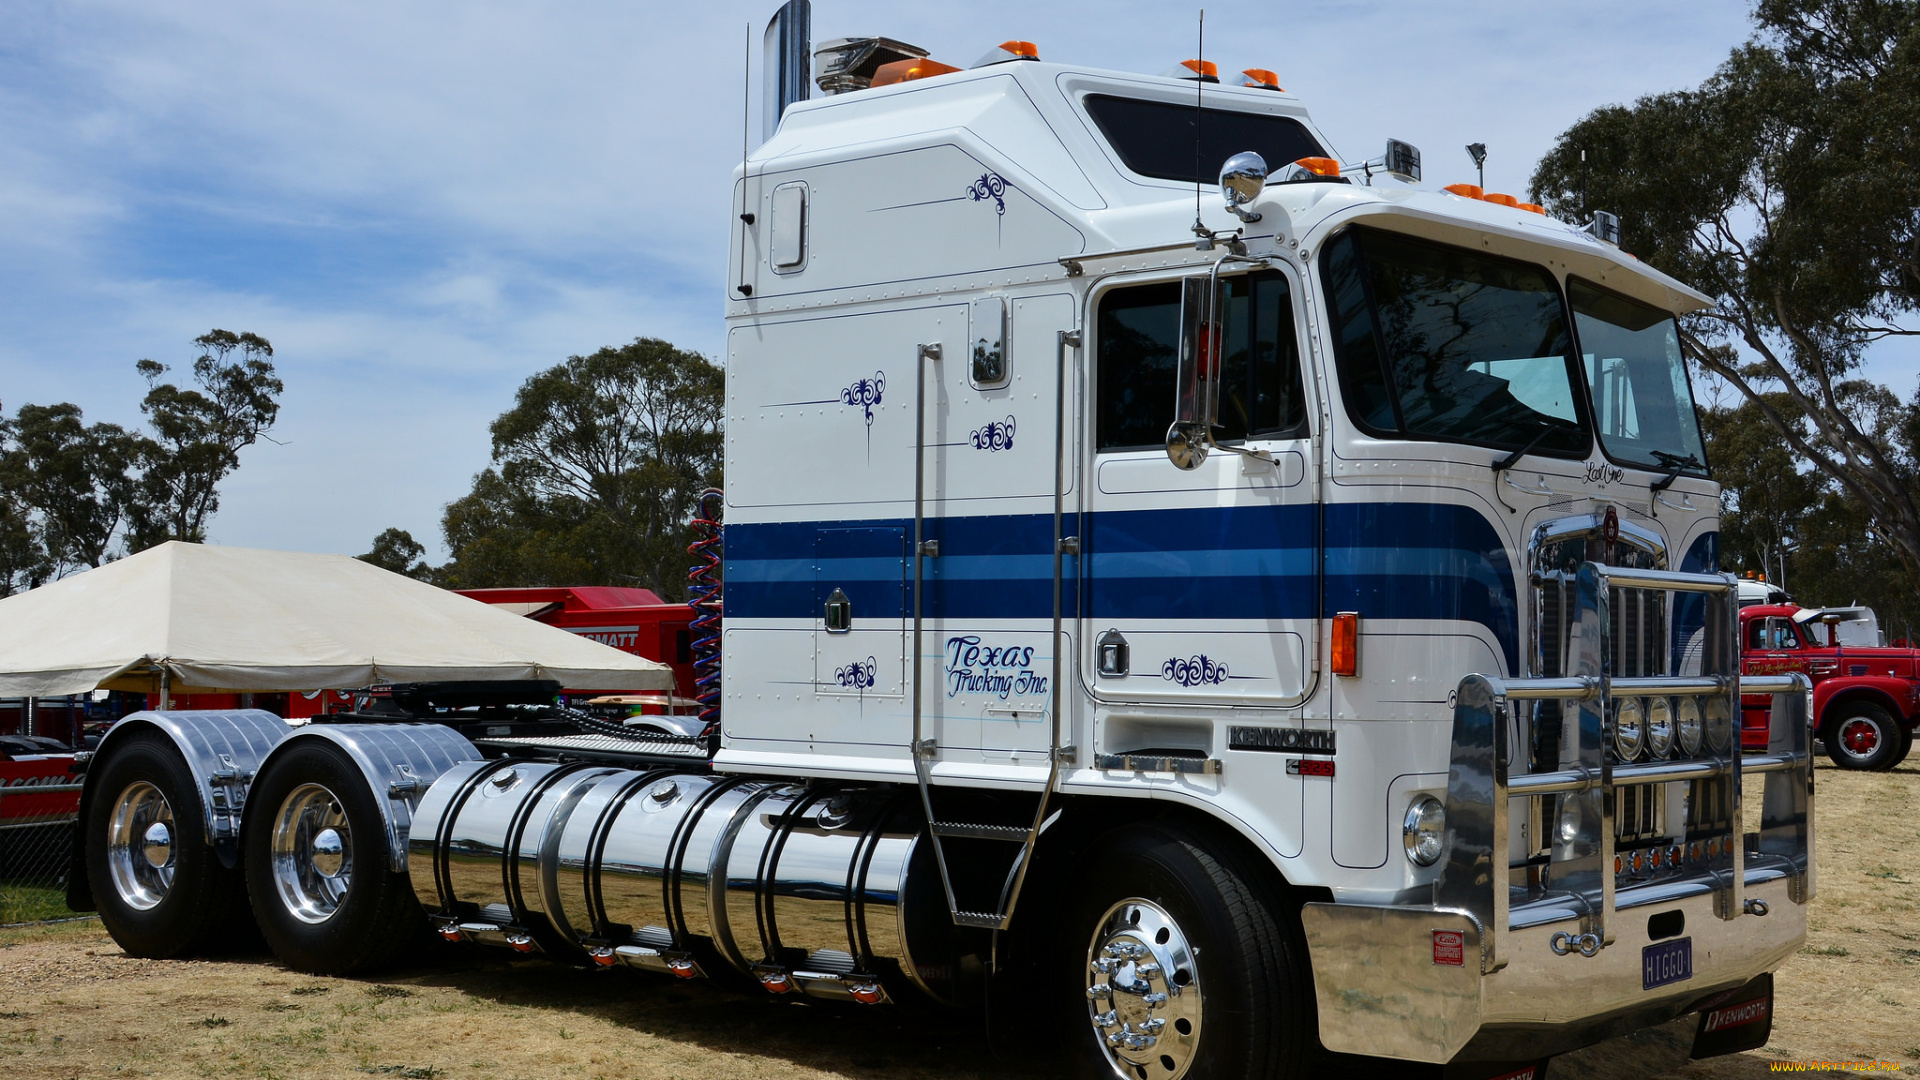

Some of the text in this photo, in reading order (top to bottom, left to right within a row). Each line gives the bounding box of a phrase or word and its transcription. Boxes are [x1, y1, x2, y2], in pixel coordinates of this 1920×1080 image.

[1604, 464, 1624, 484] One
[945, 635, 1035, 673] Texas
[947, 668, 1048, 700] Trucking Inc.
[1230, 725, 1336, 750] KENWORTH
[1718, 1001, 1766, 1027] KENWORTH
